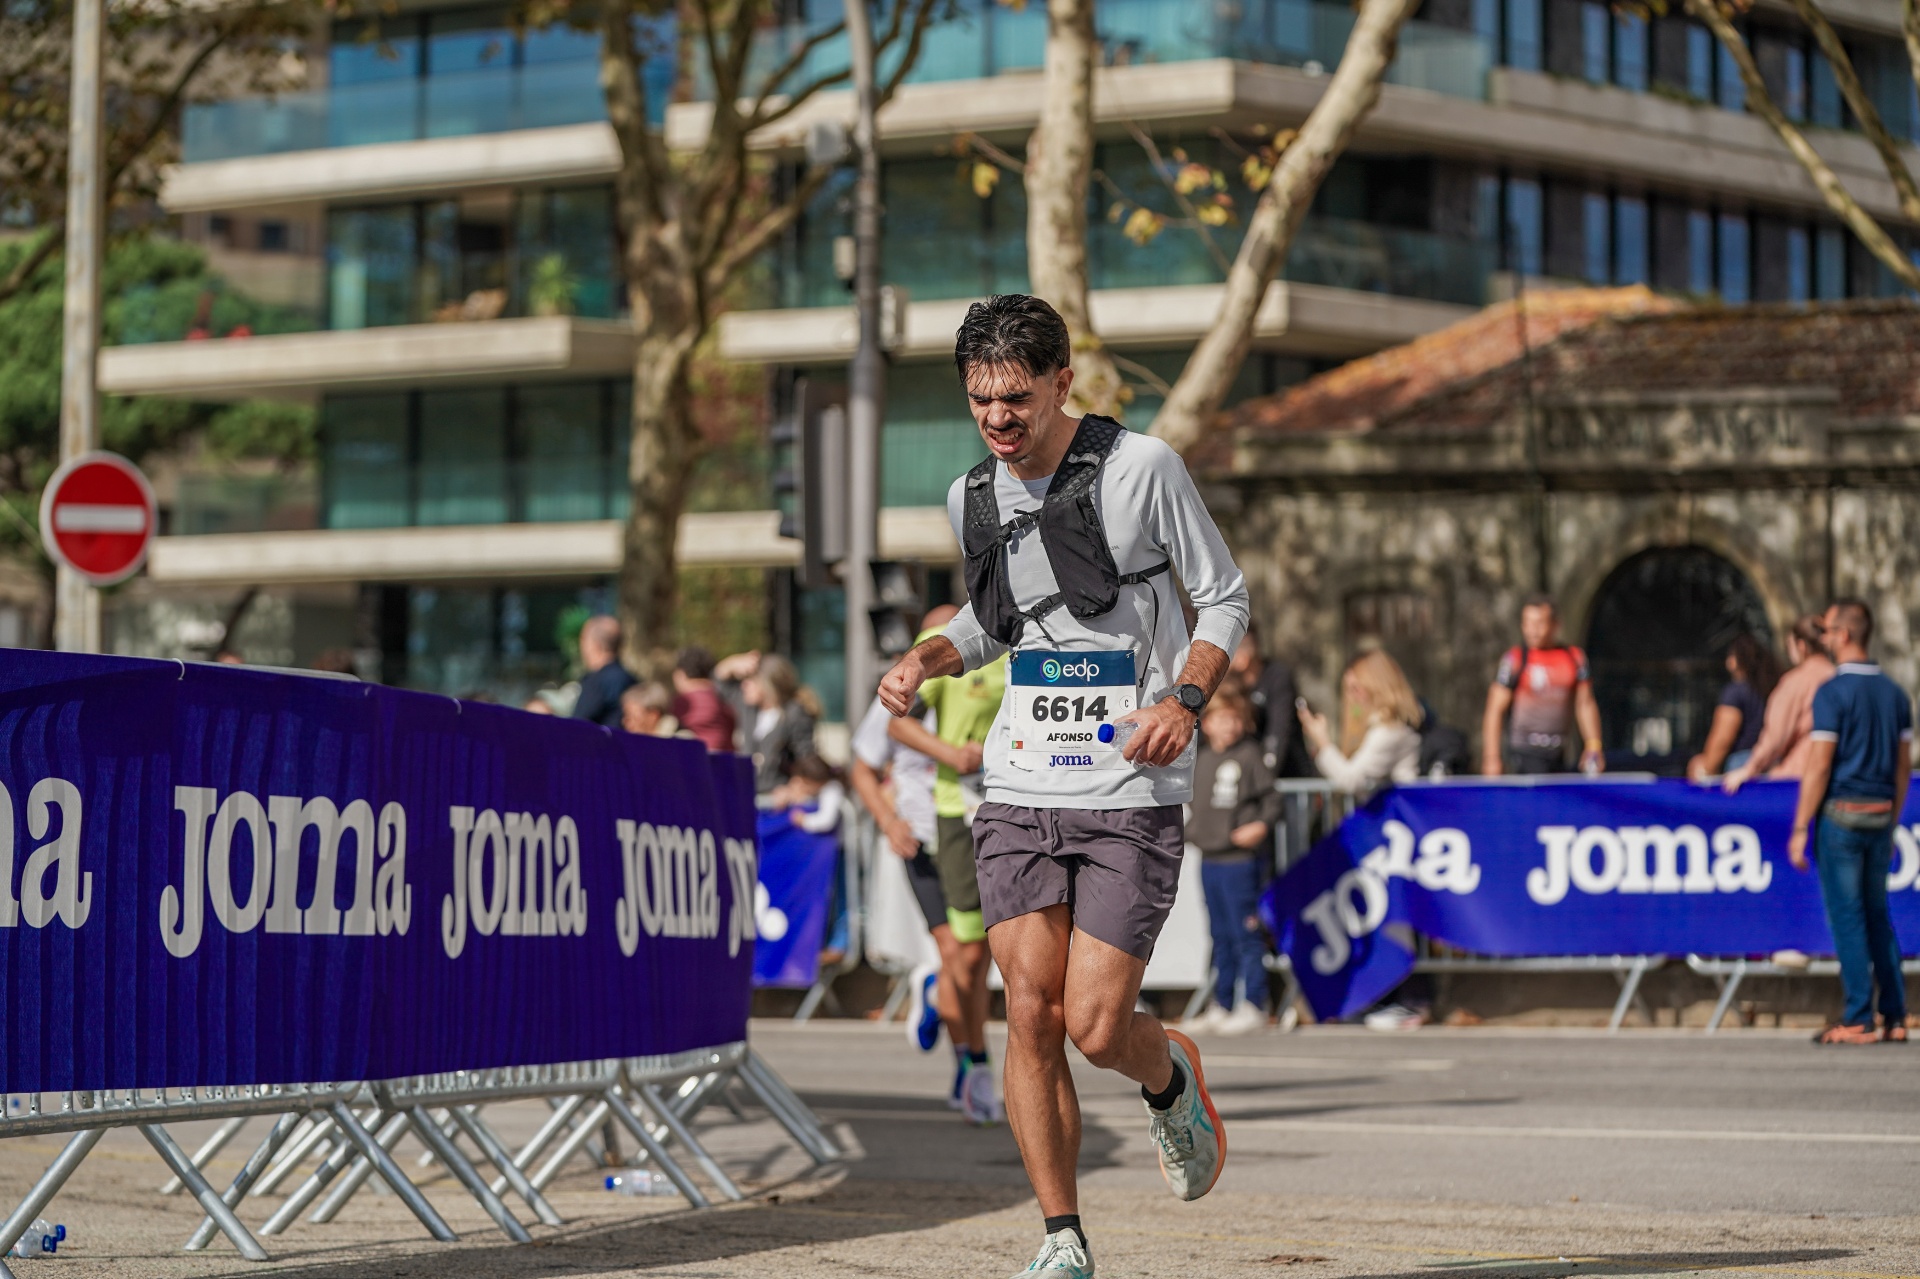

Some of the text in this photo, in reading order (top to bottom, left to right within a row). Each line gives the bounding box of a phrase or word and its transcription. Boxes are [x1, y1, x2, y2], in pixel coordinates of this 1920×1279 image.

[1032, 695, 1109, 722] 6614
[1062, 658, 1100, 682] edp
[1046, 732, 1094, 742] AFONSO
[1048, 754, 1094, 768] Joma
[0, 777, 93, 929] a
[159, 785, 412, 959] Joma
[441, 805, 588, 960] Joma
[615, 818, 721, 957] Joma
[1526, 823, 1773, 906] Joma
